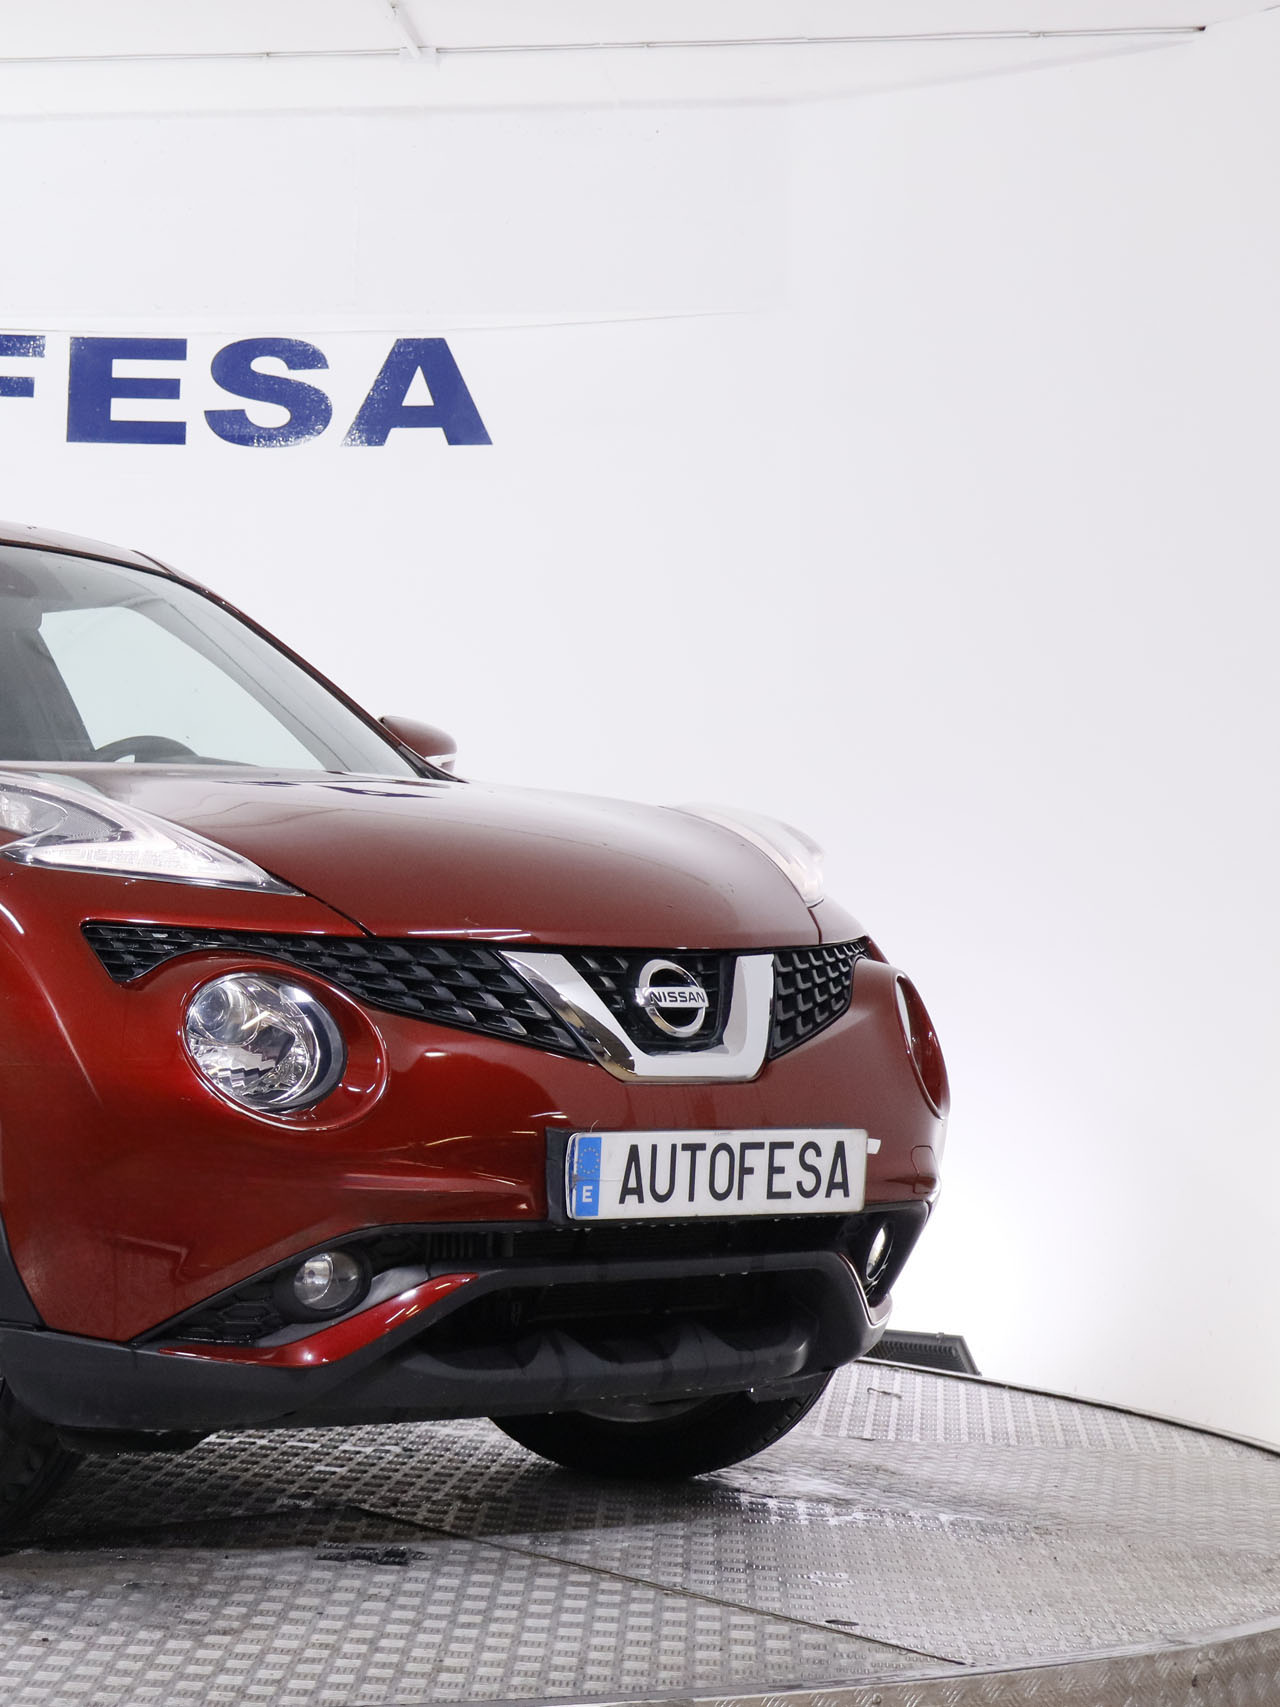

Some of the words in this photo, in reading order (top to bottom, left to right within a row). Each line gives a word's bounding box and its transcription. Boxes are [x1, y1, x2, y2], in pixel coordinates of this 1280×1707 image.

[650, 991, 706, 1003] NISSAN
[618, 1140, 850, 1205] AUTOFESA
[582, 1186, 593, 1202] E
